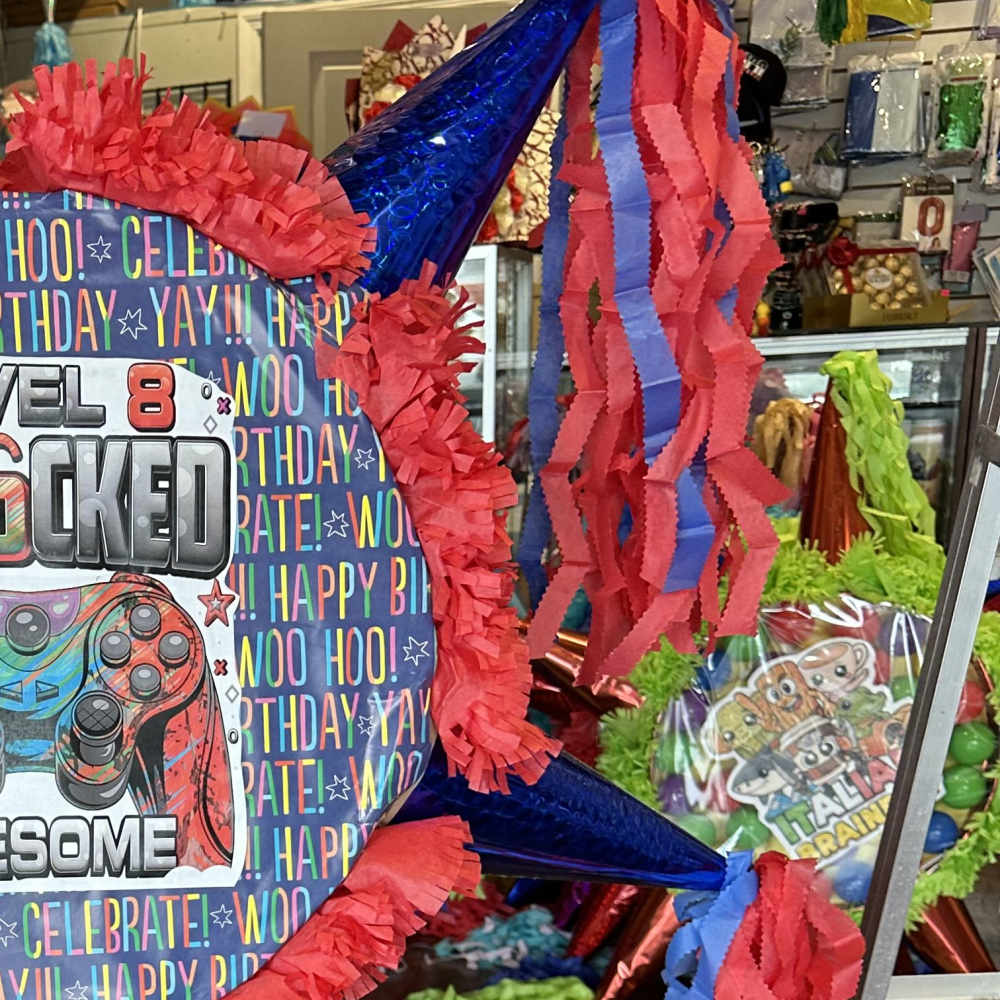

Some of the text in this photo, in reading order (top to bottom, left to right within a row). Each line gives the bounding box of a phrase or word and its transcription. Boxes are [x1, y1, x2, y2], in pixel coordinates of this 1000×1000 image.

[5, 217, 85, 281] HOO!
[149, 283, 253, 347] YAY!!!
[126, 361, 176, 432] 8
[268, 561, 378, 623] HAPPY
[324, 625, 398, 686] HOO!
[774, 749, 901, 845] ITALIA
[21, 892, 210, 960] CELEBRATE!
